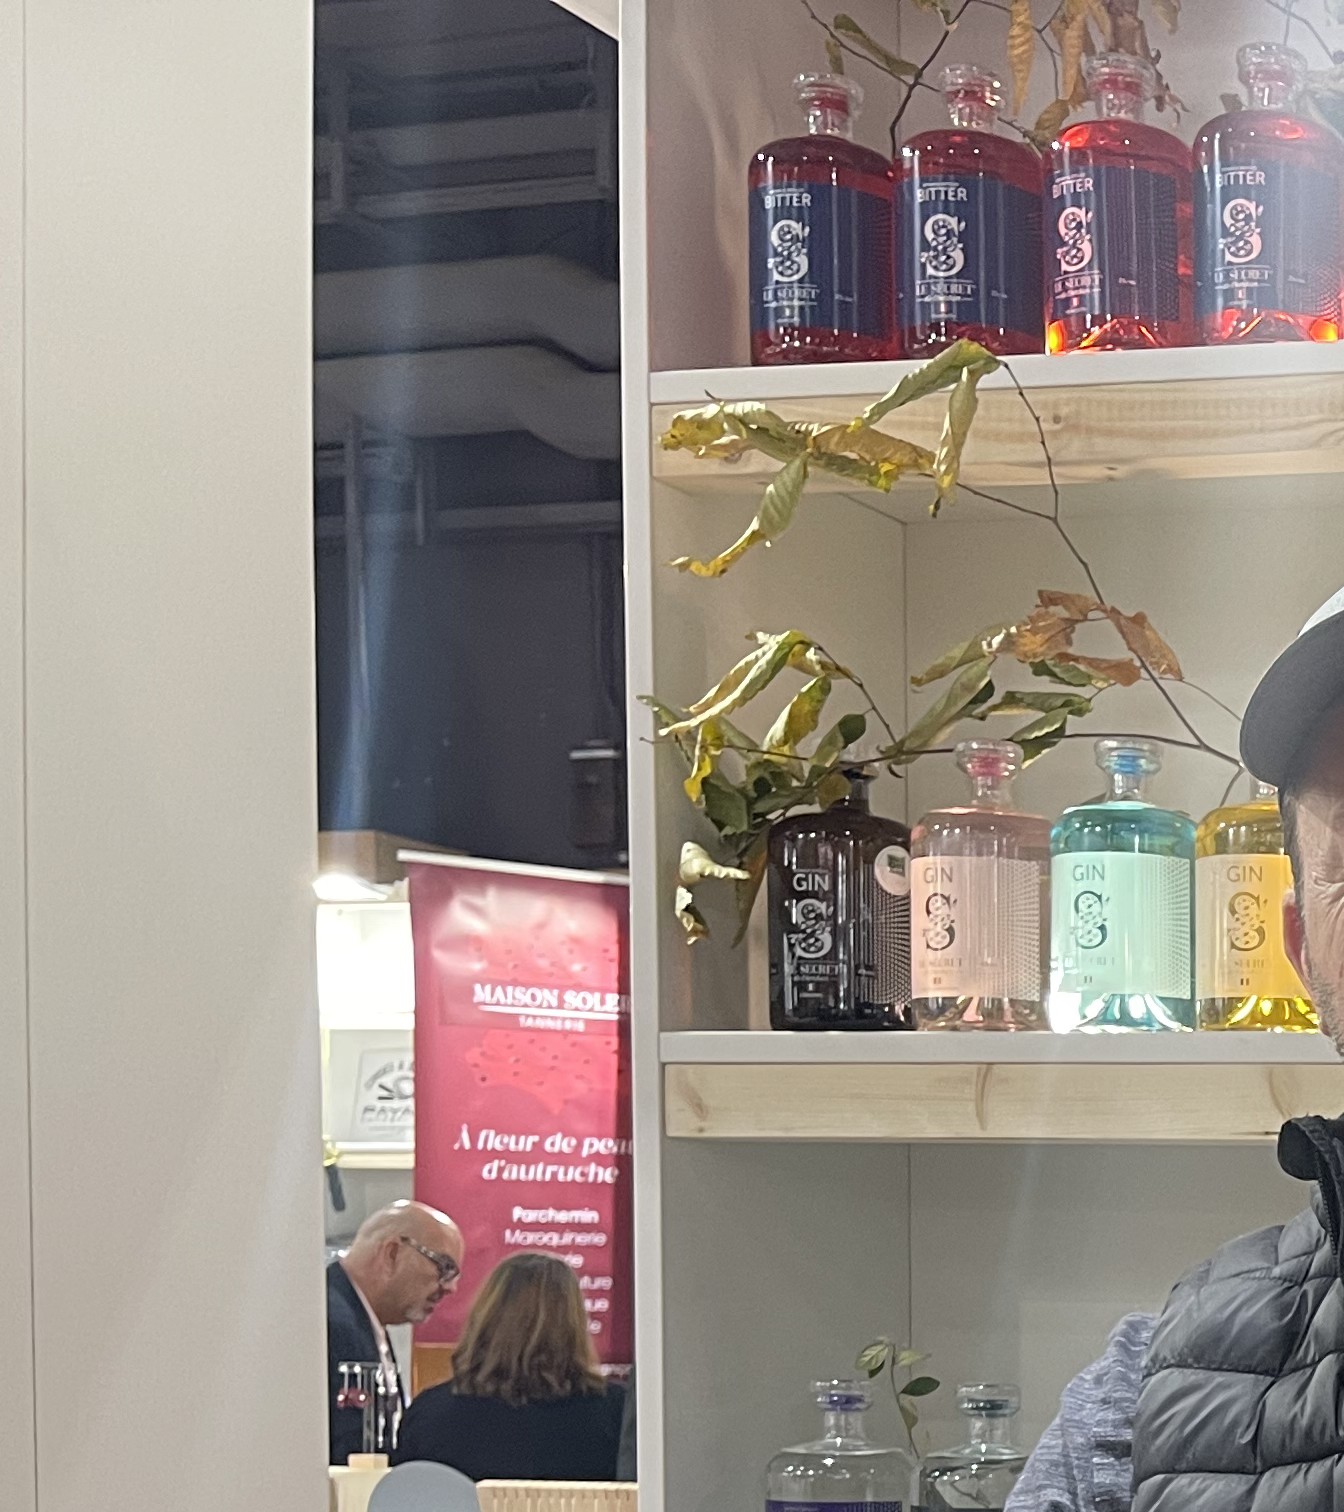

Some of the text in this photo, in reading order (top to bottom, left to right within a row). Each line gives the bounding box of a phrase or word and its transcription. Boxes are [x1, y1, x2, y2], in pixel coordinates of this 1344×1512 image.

[1052, 178, 1094, 199] BITTER
[1216, 171, 1266, 188] BITTER
[764, 193, 811, 209] BITTER
[917, 187, 968, 203] BITTER
[792, 873, 829, 892] GIN
[923, 866, 953, 885] GIN
[1072, 864, 1105, 882] GIN
[1227, 865, 1263, 883] GIN
[473, 982, 558, 1008] MAISON
[477, 1128, 539, 1151] fleur
[544, 1131, 577, 1154] de
[481, 1158, 620, 1184] d'autruche
[512, 1205, 600, 1224] Parchemin
